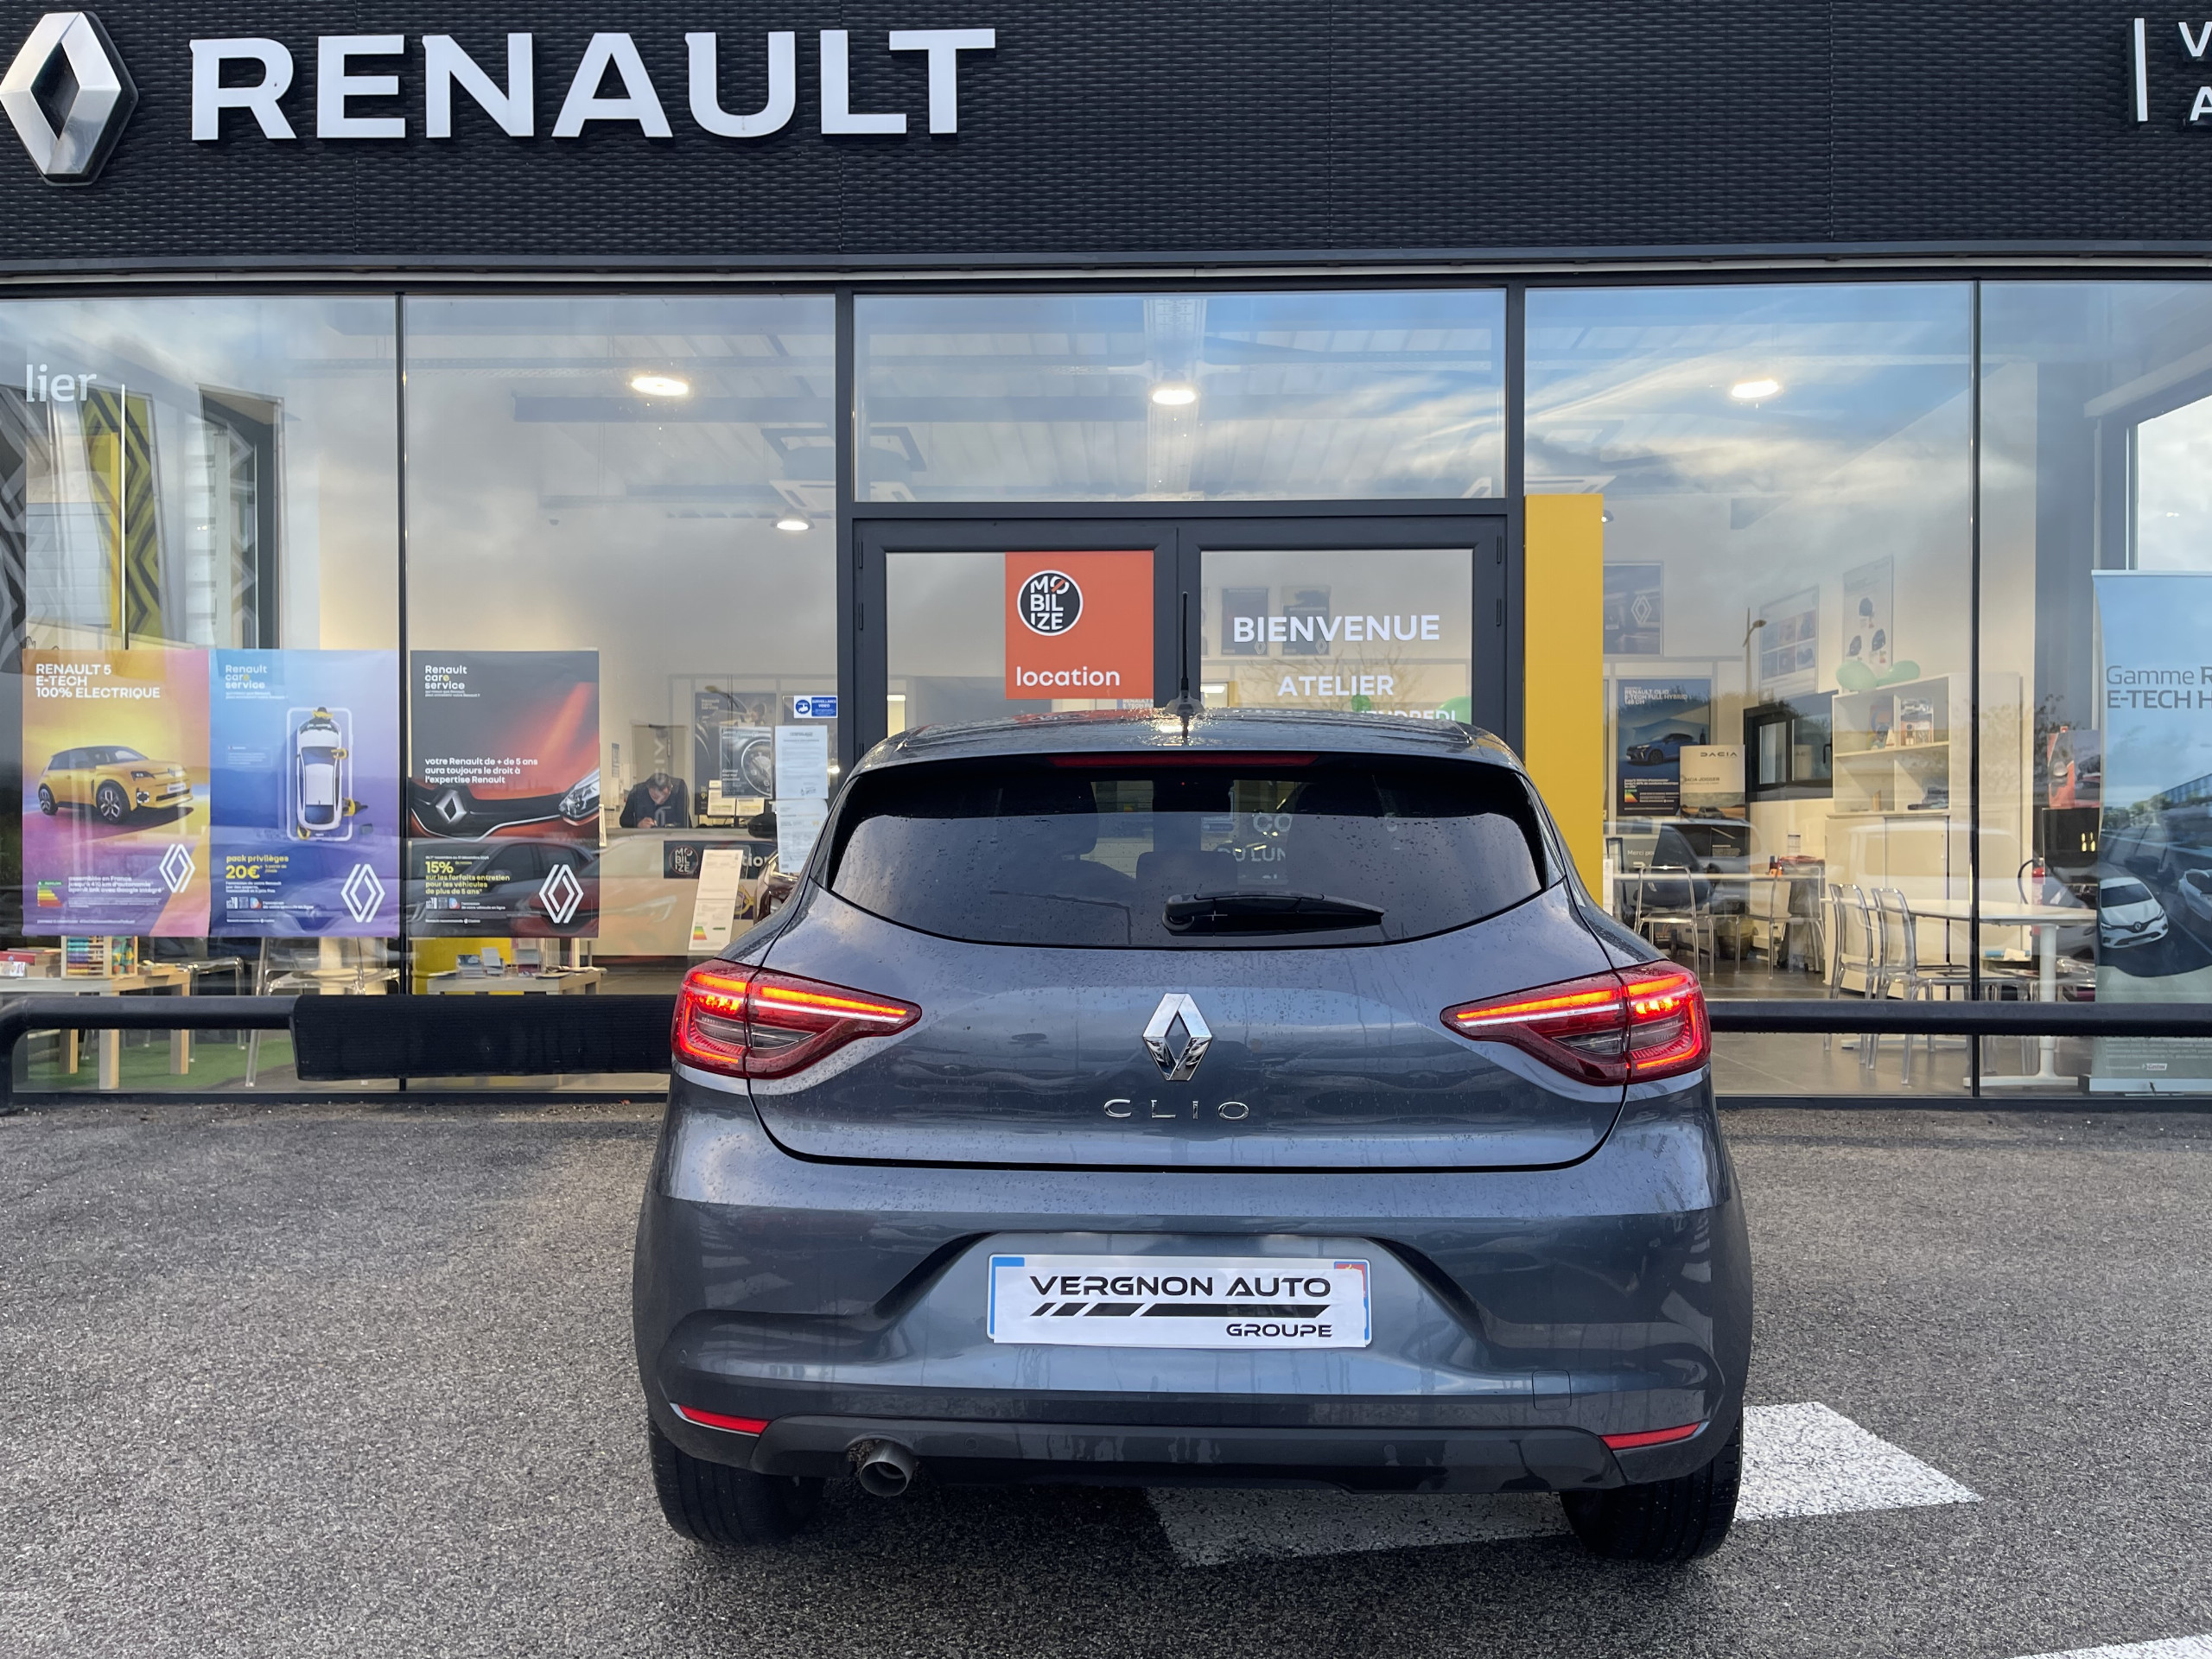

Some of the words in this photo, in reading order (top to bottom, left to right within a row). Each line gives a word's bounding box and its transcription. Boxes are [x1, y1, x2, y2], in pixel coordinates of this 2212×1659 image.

[189, 29, 996, 141] RENAULT
[26, 364, 97, 403] lier
[1233, 614, 1440, 643] BIENVENUE
[35, 664, 101, 675] RENAULT
[104, 664, 111, 675] 5
[226, 664, 267, 673] Renault
[425, 664, 467, 674] Renault
[2106, 665, 2195, 685] Gamme
[35, 676, 87, 686] E-TECH
[1016, 665, 1121, 687] location
[226, 680, 265, 689] service
[425, 681, 465, 690] service
[1277, 675, 1395, 696] ATELIER
[35, 687, 73, 698] 100%
[75, 687, 161, 700] ELECTRIQUE
[2107, 690, 2191, 709] E-TECH
[449, 757, 483, 766] Renault
[485, 757, 495, 766] de
[504, 757, 514, 766] de
[447, 766, 482, 776] toujours
[425, 776, 470, 785] l'expertise
[226, 855, 246, 864] pack
[247, 854, 289, 864] privilèges
[425, 861, 454, 874] 15%
[1103, 1098, 1249, 1120] CLIO
[1029, 1275, 1213, 1297] VERGNON
[1225, 1276, 1332, 1298] AUTO
[1225, 1323, 1332, 1338] GROUPE
